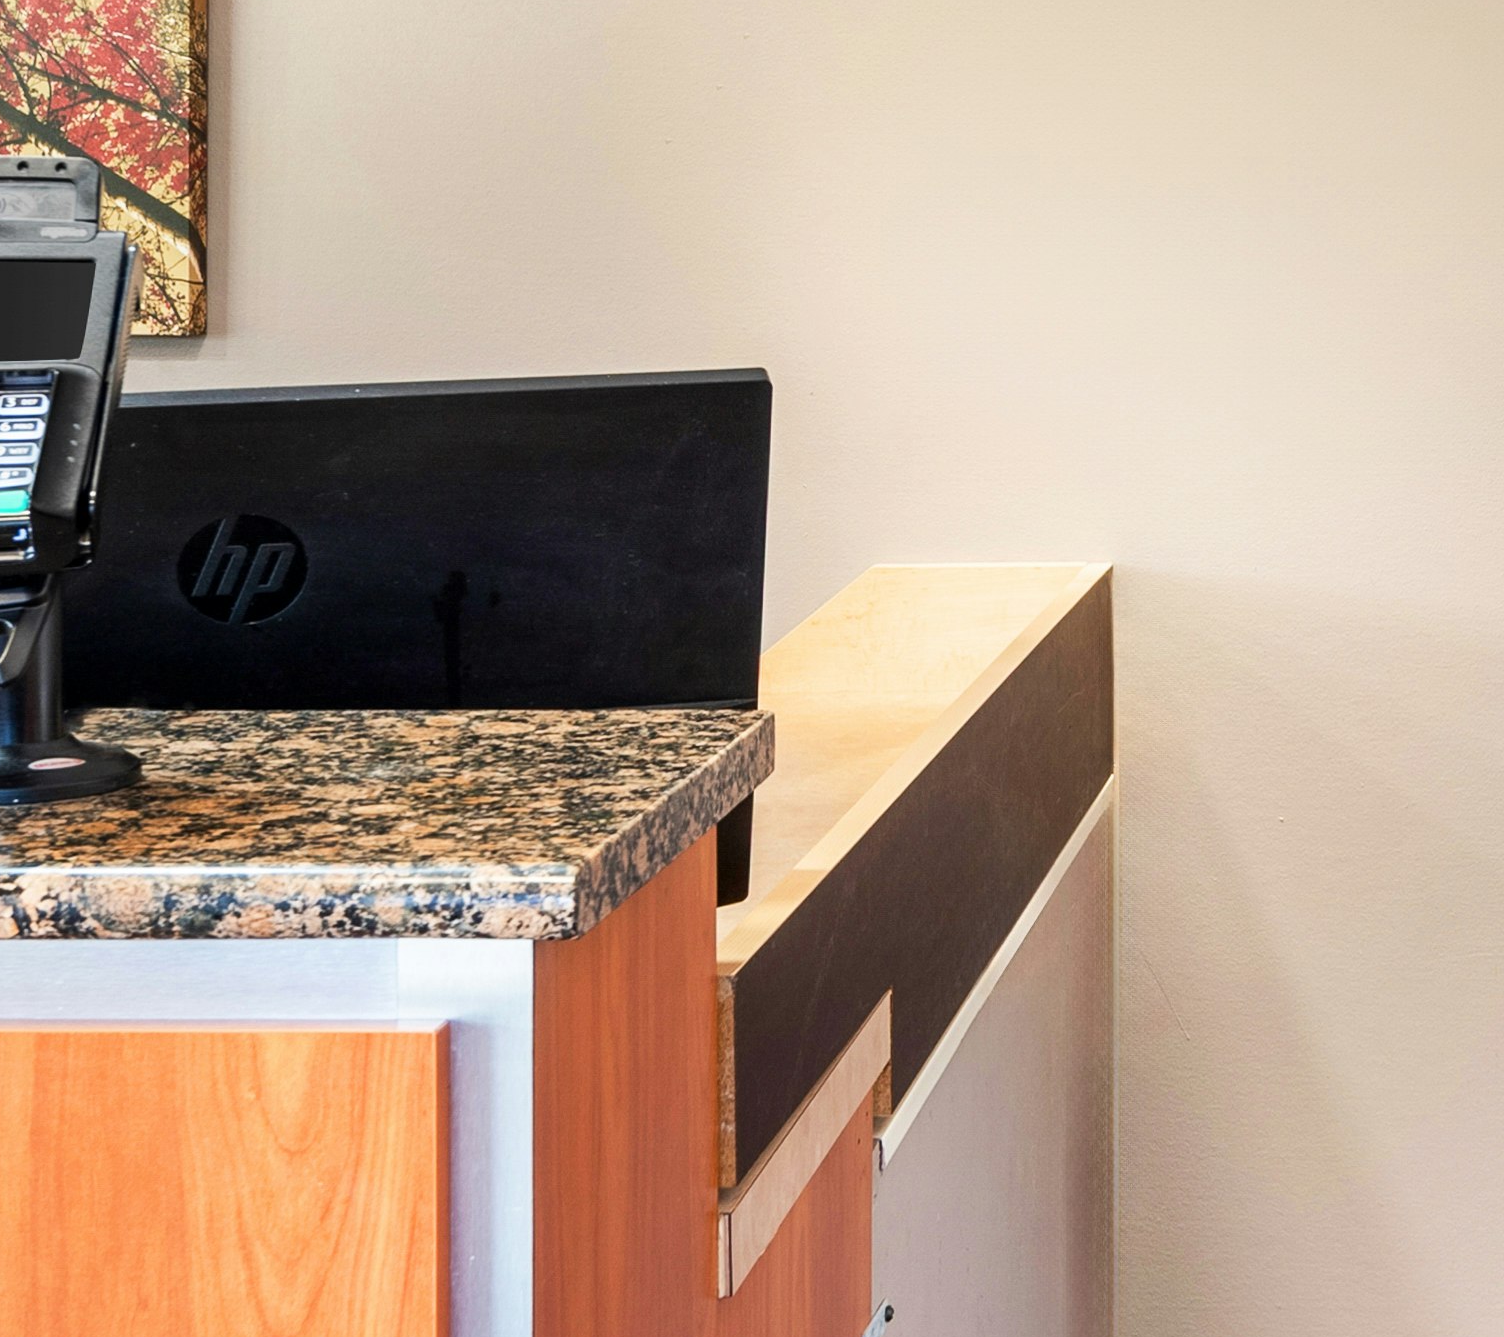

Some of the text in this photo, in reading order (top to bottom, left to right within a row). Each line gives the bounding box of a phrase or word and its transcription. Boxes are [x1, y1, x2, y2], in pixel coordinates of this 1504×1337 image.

[5, 398, 16, 408] 3
[0, 421, 10, 432] 6
[191, 514, 295, 625] hp
